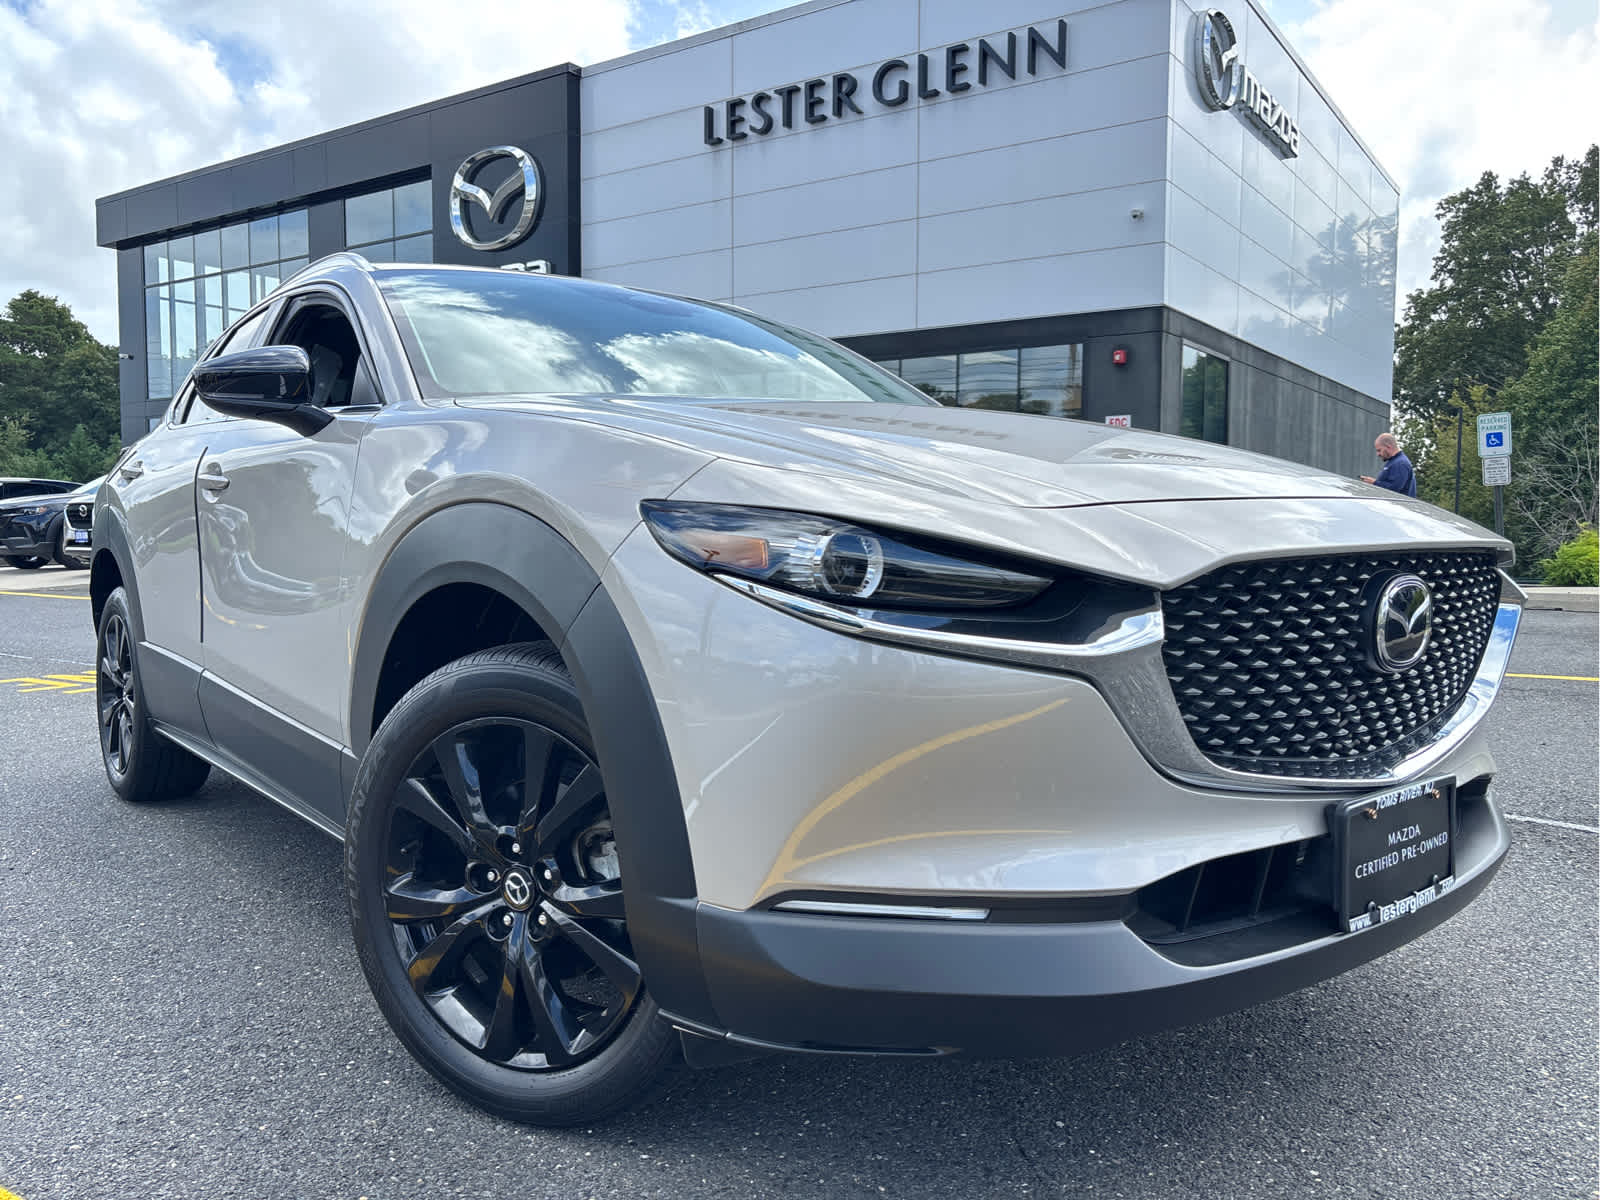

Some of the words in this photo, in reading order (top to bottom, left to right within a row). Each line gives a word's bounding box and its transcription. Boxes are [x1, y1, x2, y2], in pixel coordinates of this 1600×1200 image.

[704, 72, 864, 146] LESTER
[872, 19, 1067, 107] GLENN
[1375, 792, 1399, 810] TOMS
[1424, 781, 1434, 795] NJ
[1388, 824, 1421, 847] MAZDA
[1355, 852, 1399, 879] CERTIFIED
[1401, 831, 1448, 861] PRE-OWNED
